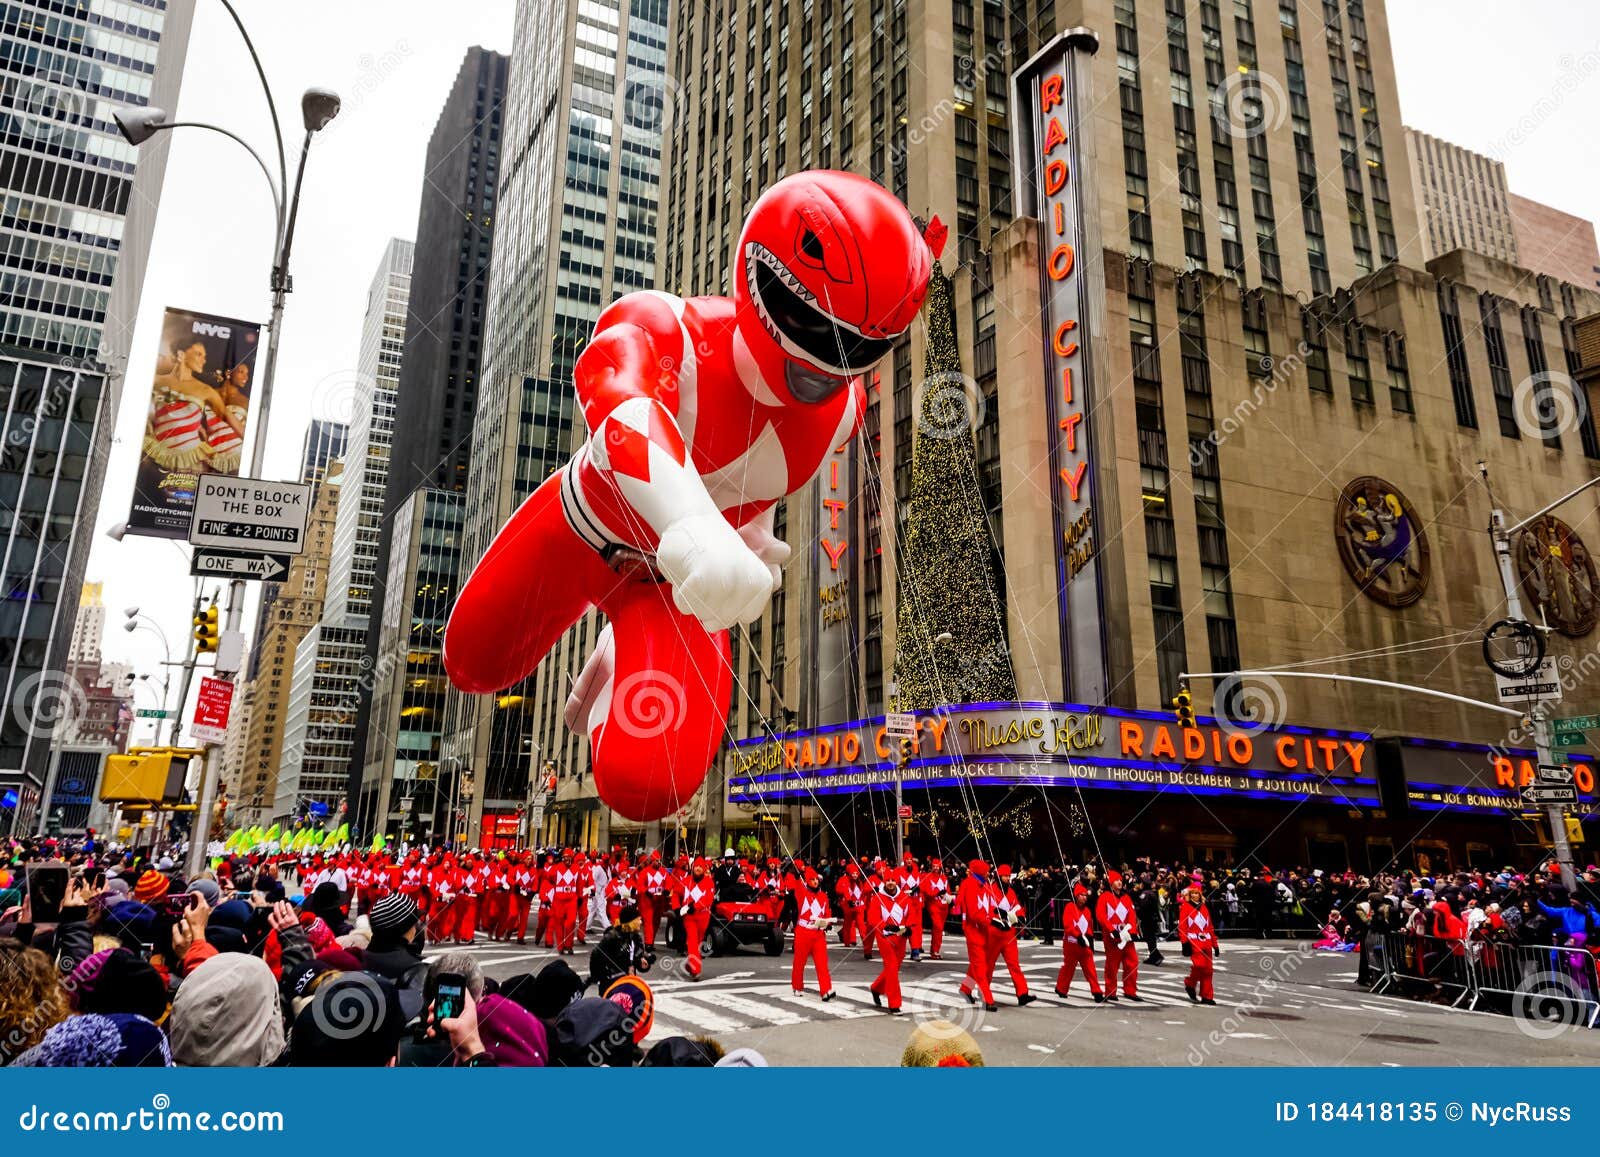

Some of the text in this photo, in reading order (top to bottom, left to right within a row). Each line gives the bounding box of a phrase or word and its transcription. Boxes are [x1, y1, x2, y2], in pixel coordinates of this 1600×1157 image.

[1041, 74, 1074, 280] RADIO
[192, 321, 231, 339] NYC
[1053, 319, 1088, 502] CITY
[205, 484, 301, 505] DON'T BLOCK
[222, 501, 283, 518] THE BOX
[821, 446, 848, 571] ITY
[202, 522, 294, 541] FINE +2 POINTS
[205, 556, 276, 574] ONE WAY
[147, 710, 159, 718] 50
[960, 717, 1044, 752] Music
[1557, 720, 1597, 730] AMERICAS
[784, 715, 949, 768] RADIO CTY
[1119, 721, 1366, 773] RADIO CITY
[1562, 735, 1571, 746] 6
[749, 781, 767, 793] RADIO
[770, 779, 783, 791] CITY
[825, 771, 877, 787] SPECTACULAR
[882, 767, 921, 782] STARING
[927, 765, 943, 778] THE
[1069, 765, 1097, 779] NOW
[1106, 766, 1163, 783] THROUGH
[1170, 772, 1232, 788] DECEMBER
[1239, 778, 1250, 789] 31
[1256, 779, 1322, 794] #JOYTOALL
[1493, 755, 1594, 793] RAO
[1443, 792, 1462, 805] JOE
[1467, 794, 1524, 810] BONAMASSA
[1580, 804, 1592, 814] 24
[1525, 790, 1571, 798] ONE WAY
